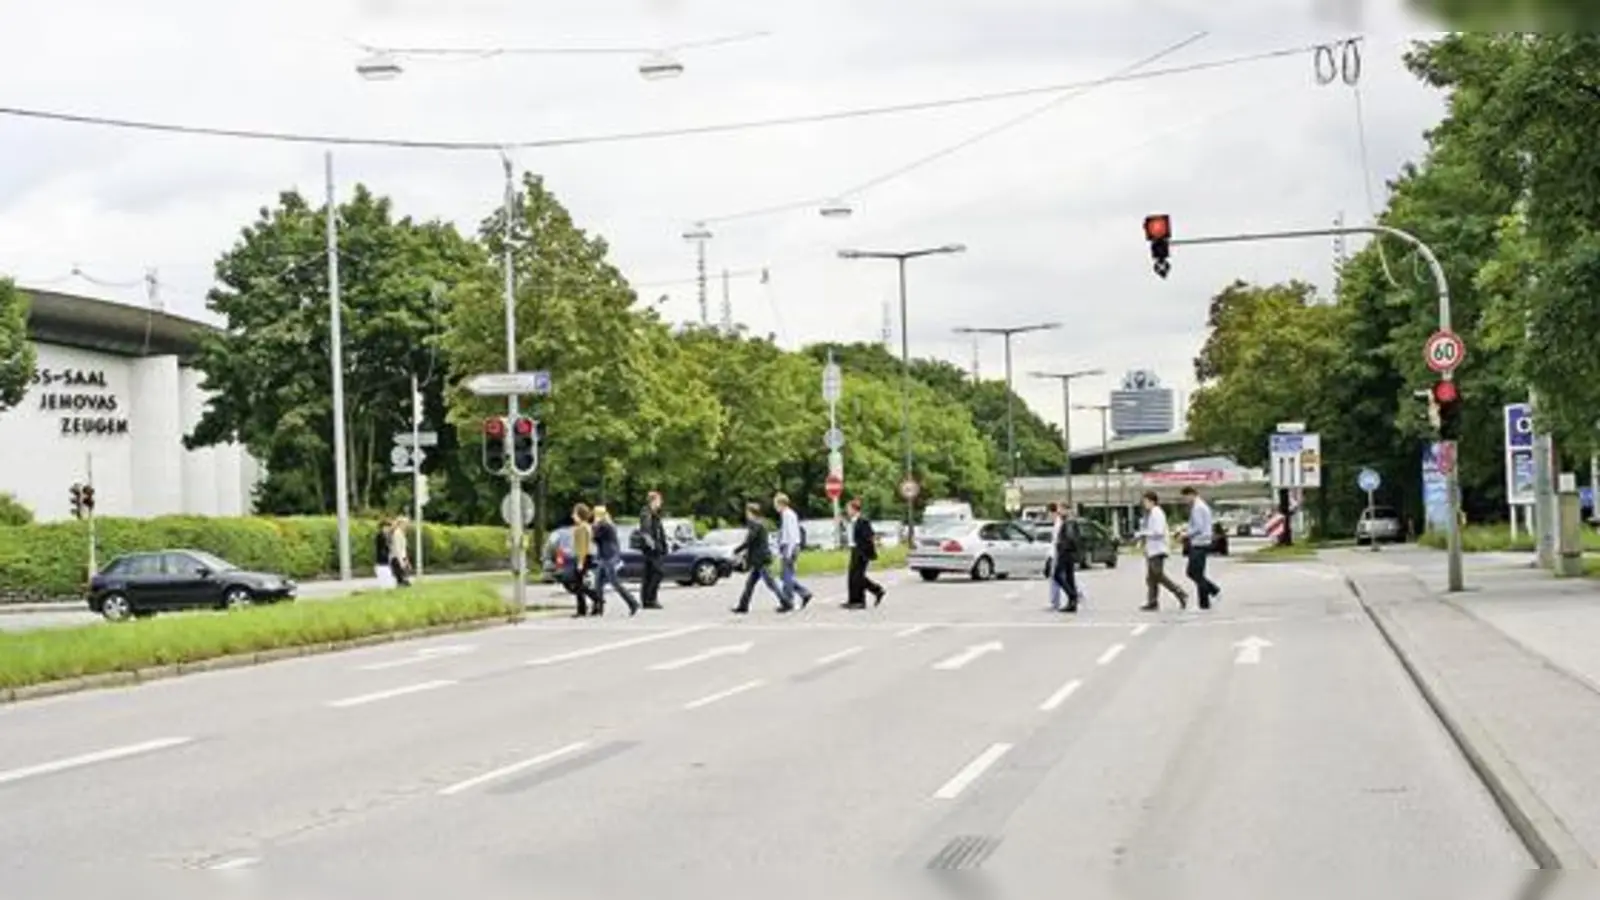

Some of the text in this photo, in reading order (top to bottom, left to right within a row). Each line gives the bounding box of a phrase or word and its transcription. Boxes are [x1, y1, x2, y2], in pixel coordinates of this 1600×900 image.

[1434, 342, 1455, 361] 60
[39, 393, 117, 412] JEHOVAS
[60, 417, 129, 435] ZEUGEN
